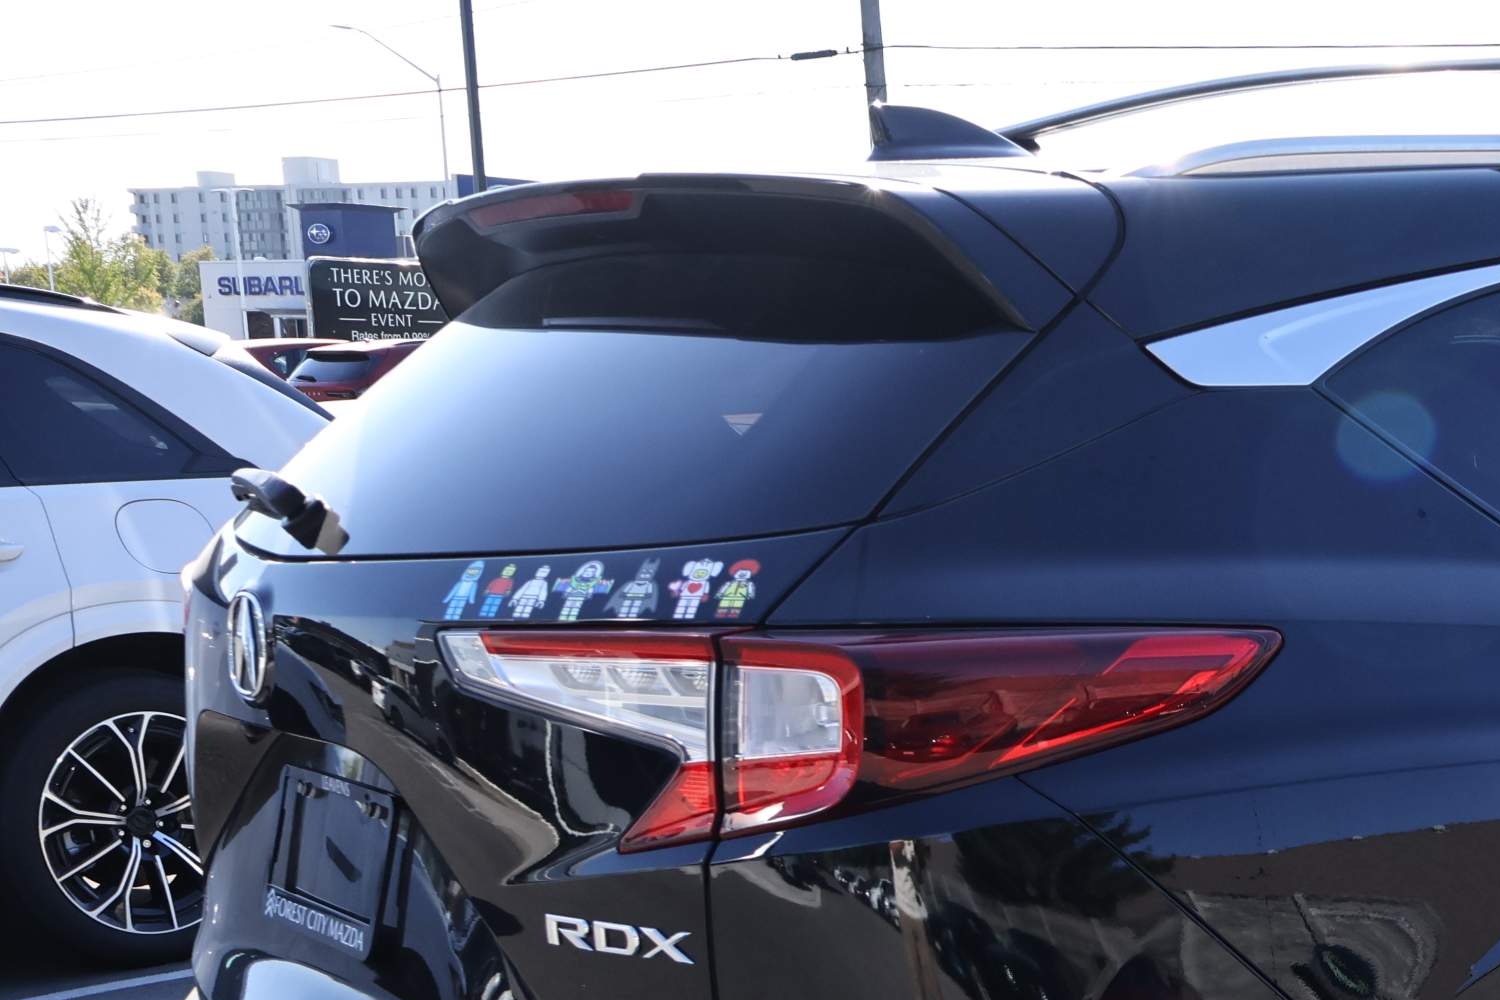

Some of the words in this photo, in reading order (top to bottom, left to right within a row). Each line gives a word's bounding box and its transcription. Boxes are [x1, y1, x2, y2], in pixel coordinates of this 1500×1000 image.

[330, 267, 393, 286] THERE'S
[399, 271, 431, 287] MO
[332, 288, 361, 308] TO
[370, 313, 413, 327] EVENT
[351, 330, 378, 341] Rates
[274, 895, 307, 926] FOREST
[306, 909, 329, 935] CITY
[327, 918, 364, 951] MAZDA
[545, 913, 695, 965] RDX
